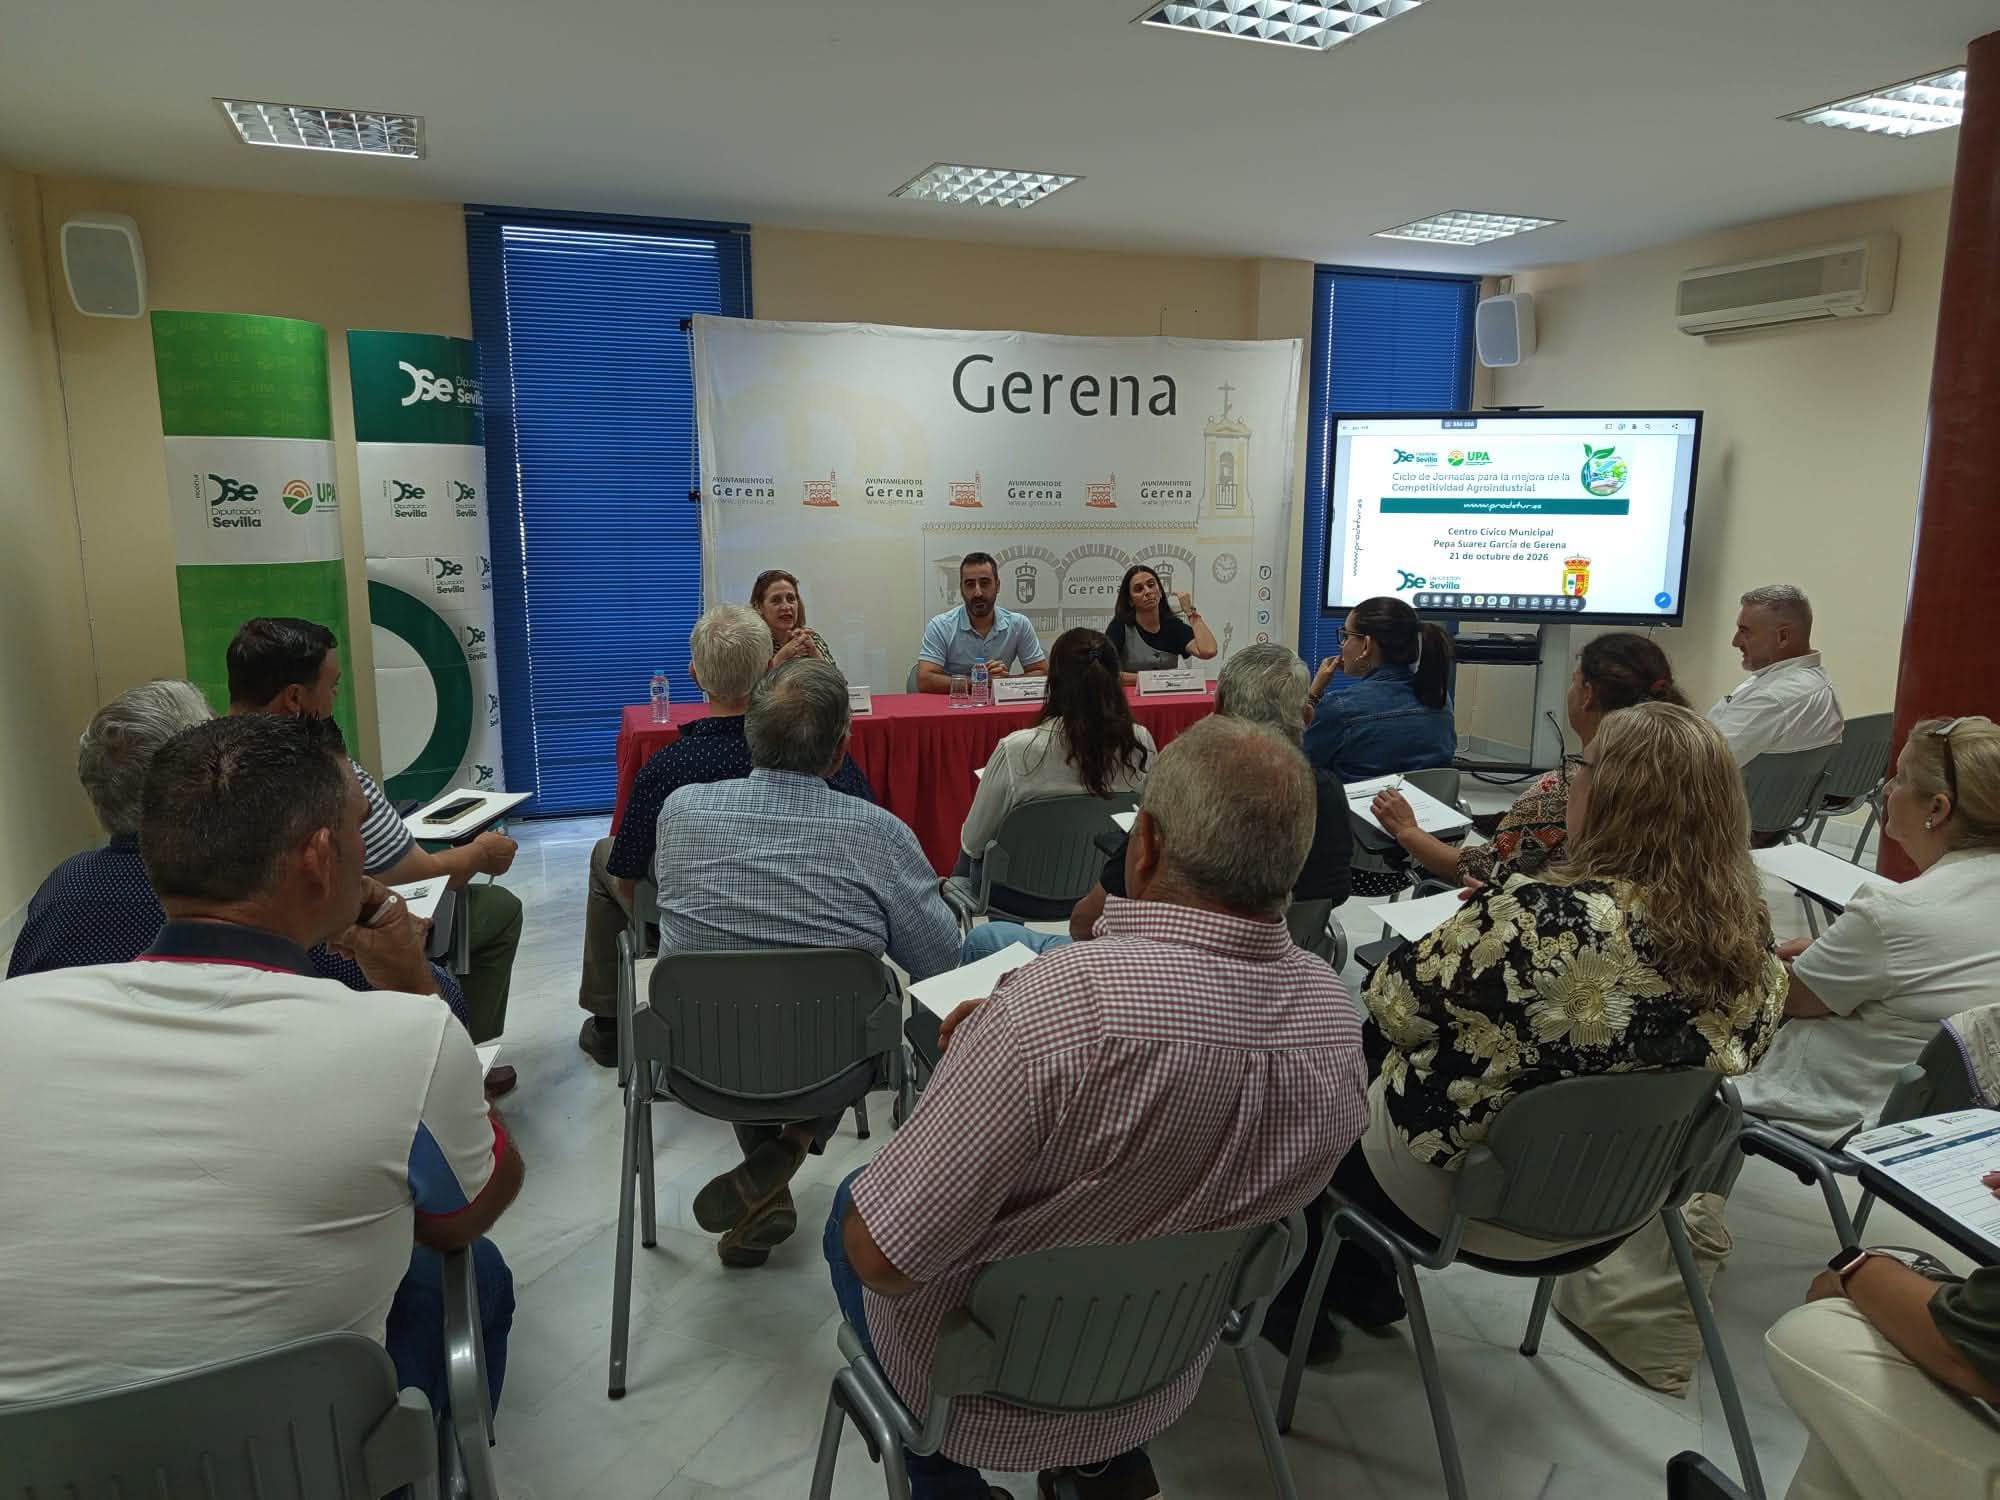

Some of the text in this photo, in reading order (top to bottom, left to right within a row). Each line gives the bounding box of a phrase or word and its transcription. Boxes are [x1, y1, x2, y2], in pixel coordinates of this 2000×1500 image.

[952, 353, 1177, 417] Gerena
[1467, 451, 1490, 461] UPA
[712, 476, 765, 484] AYUNTAMIENTO
[1392, 472, 1570, 483] Ciclo de Jornadas para la mejora de la
[316, 482, 336, 503] UPA
[712, 484, 775, 497] Gerena
[865, 486, 924, 498] Gerena
[1007, 487, 1062, 499] Gerena
[1392, 483, 1536, 493] Competitividad Agroindustrial
[1140, 488, 1192, 499] Gerena
[394, 509, 428, 518] Sevilla
[212, 516, 262, 528] Sevilla
[1448, 528, 1478, 536] Centro
[1509, 528, 1554, 538] Municipal
[1433, 540, 1455, 549] Pepa
[1519, 541, 1531, 549] de
[1534, 541, 1567, 549] Gerena
[1449, 552, 1460, 560] 21
[1462, 552, 1474, 560] de
[1475, 552, 1510, 561] octubre
[1512, 553, 1524, 561] de
[1068, 575, 1116, 584] AYUNTAMIENTO
[436, 585, 465, 594] Sevilla
[1429, 580, 1460, 590] Sevilla
